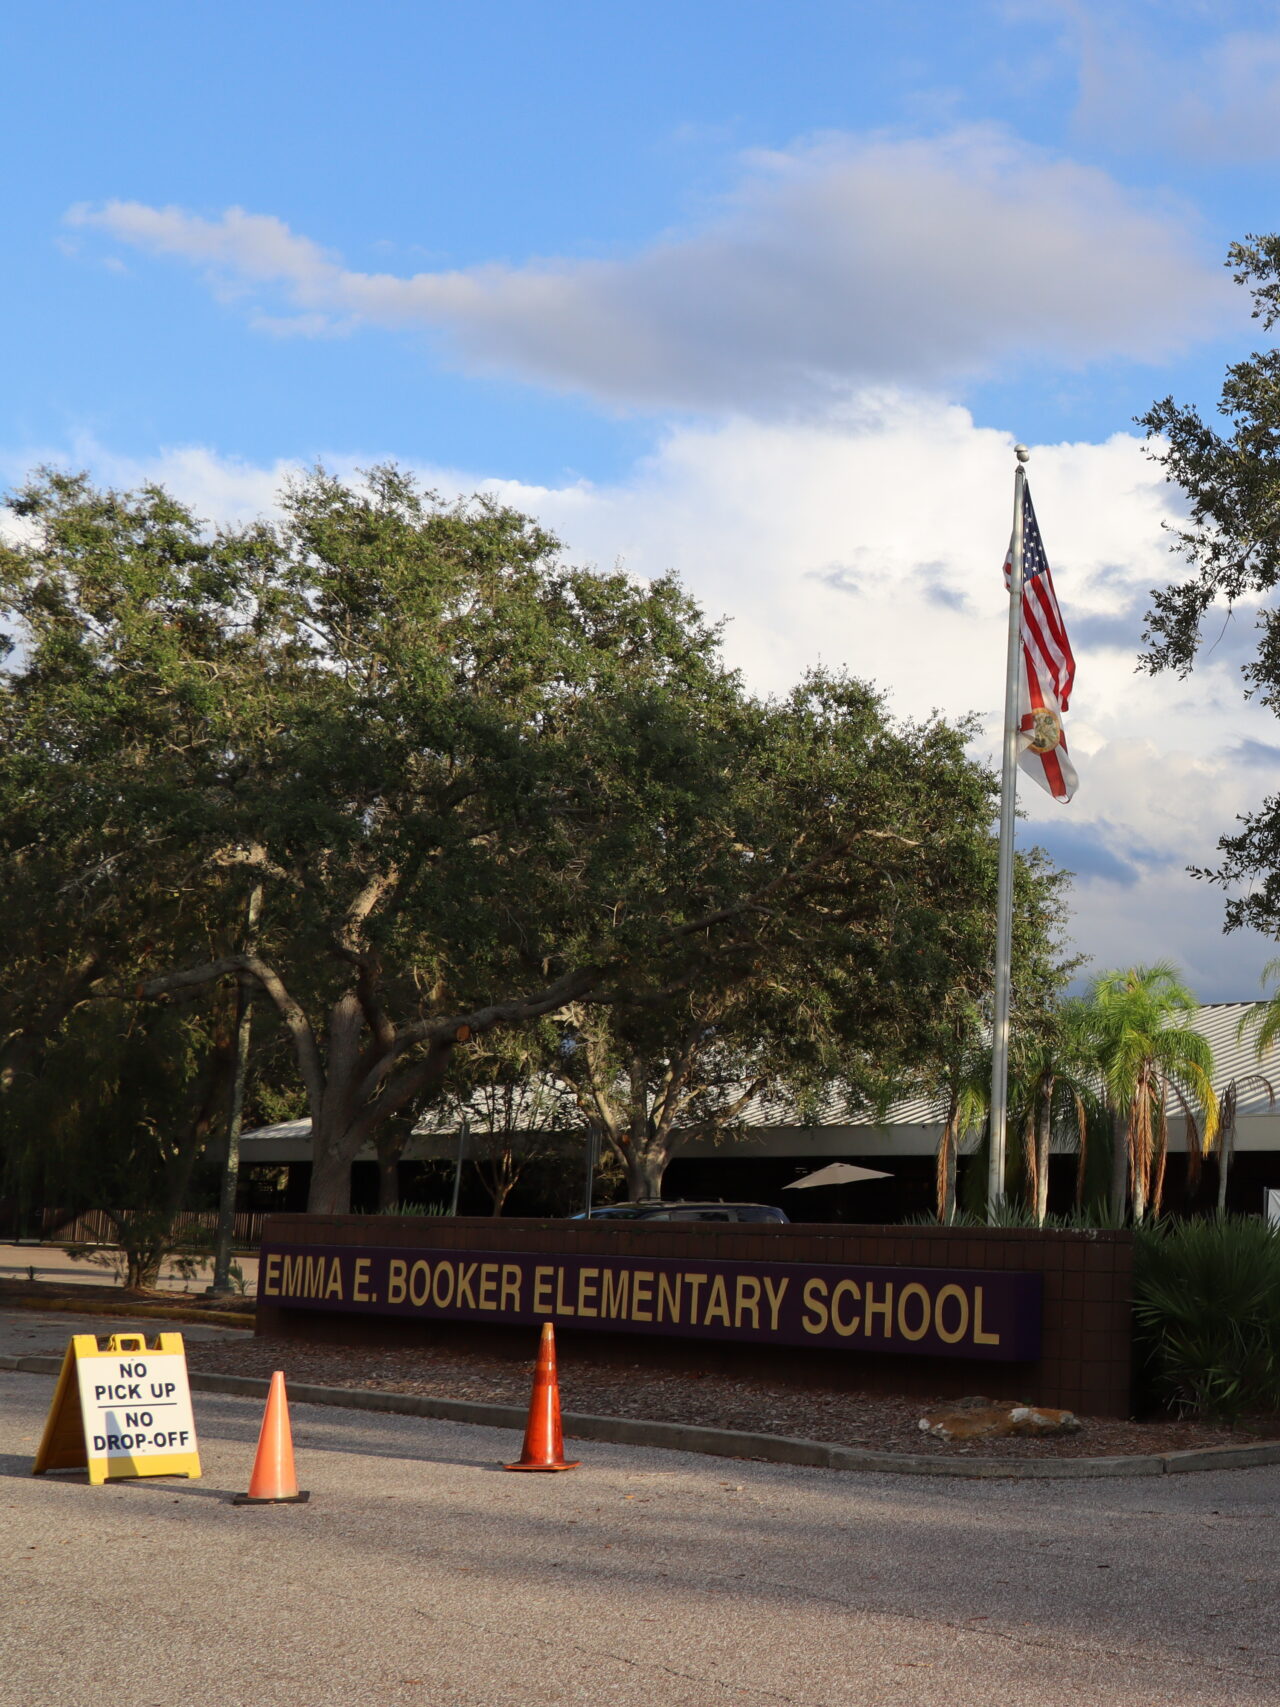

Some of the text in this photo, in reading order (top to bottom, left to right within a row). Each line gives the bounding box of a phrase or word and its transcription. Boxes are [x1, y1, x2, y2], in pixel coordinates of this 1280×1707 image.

[264, 1254, 1000, 1345] EMMA E. BOOKER ELEMENTARY SCHOOL
[119, 1363, 147, 1378] NO
[95, 1383, 176, 1400] PICK UP
[125, 1412, 153, 1427] NO
[93, 1431, 189, 1451] DROP-OFF
